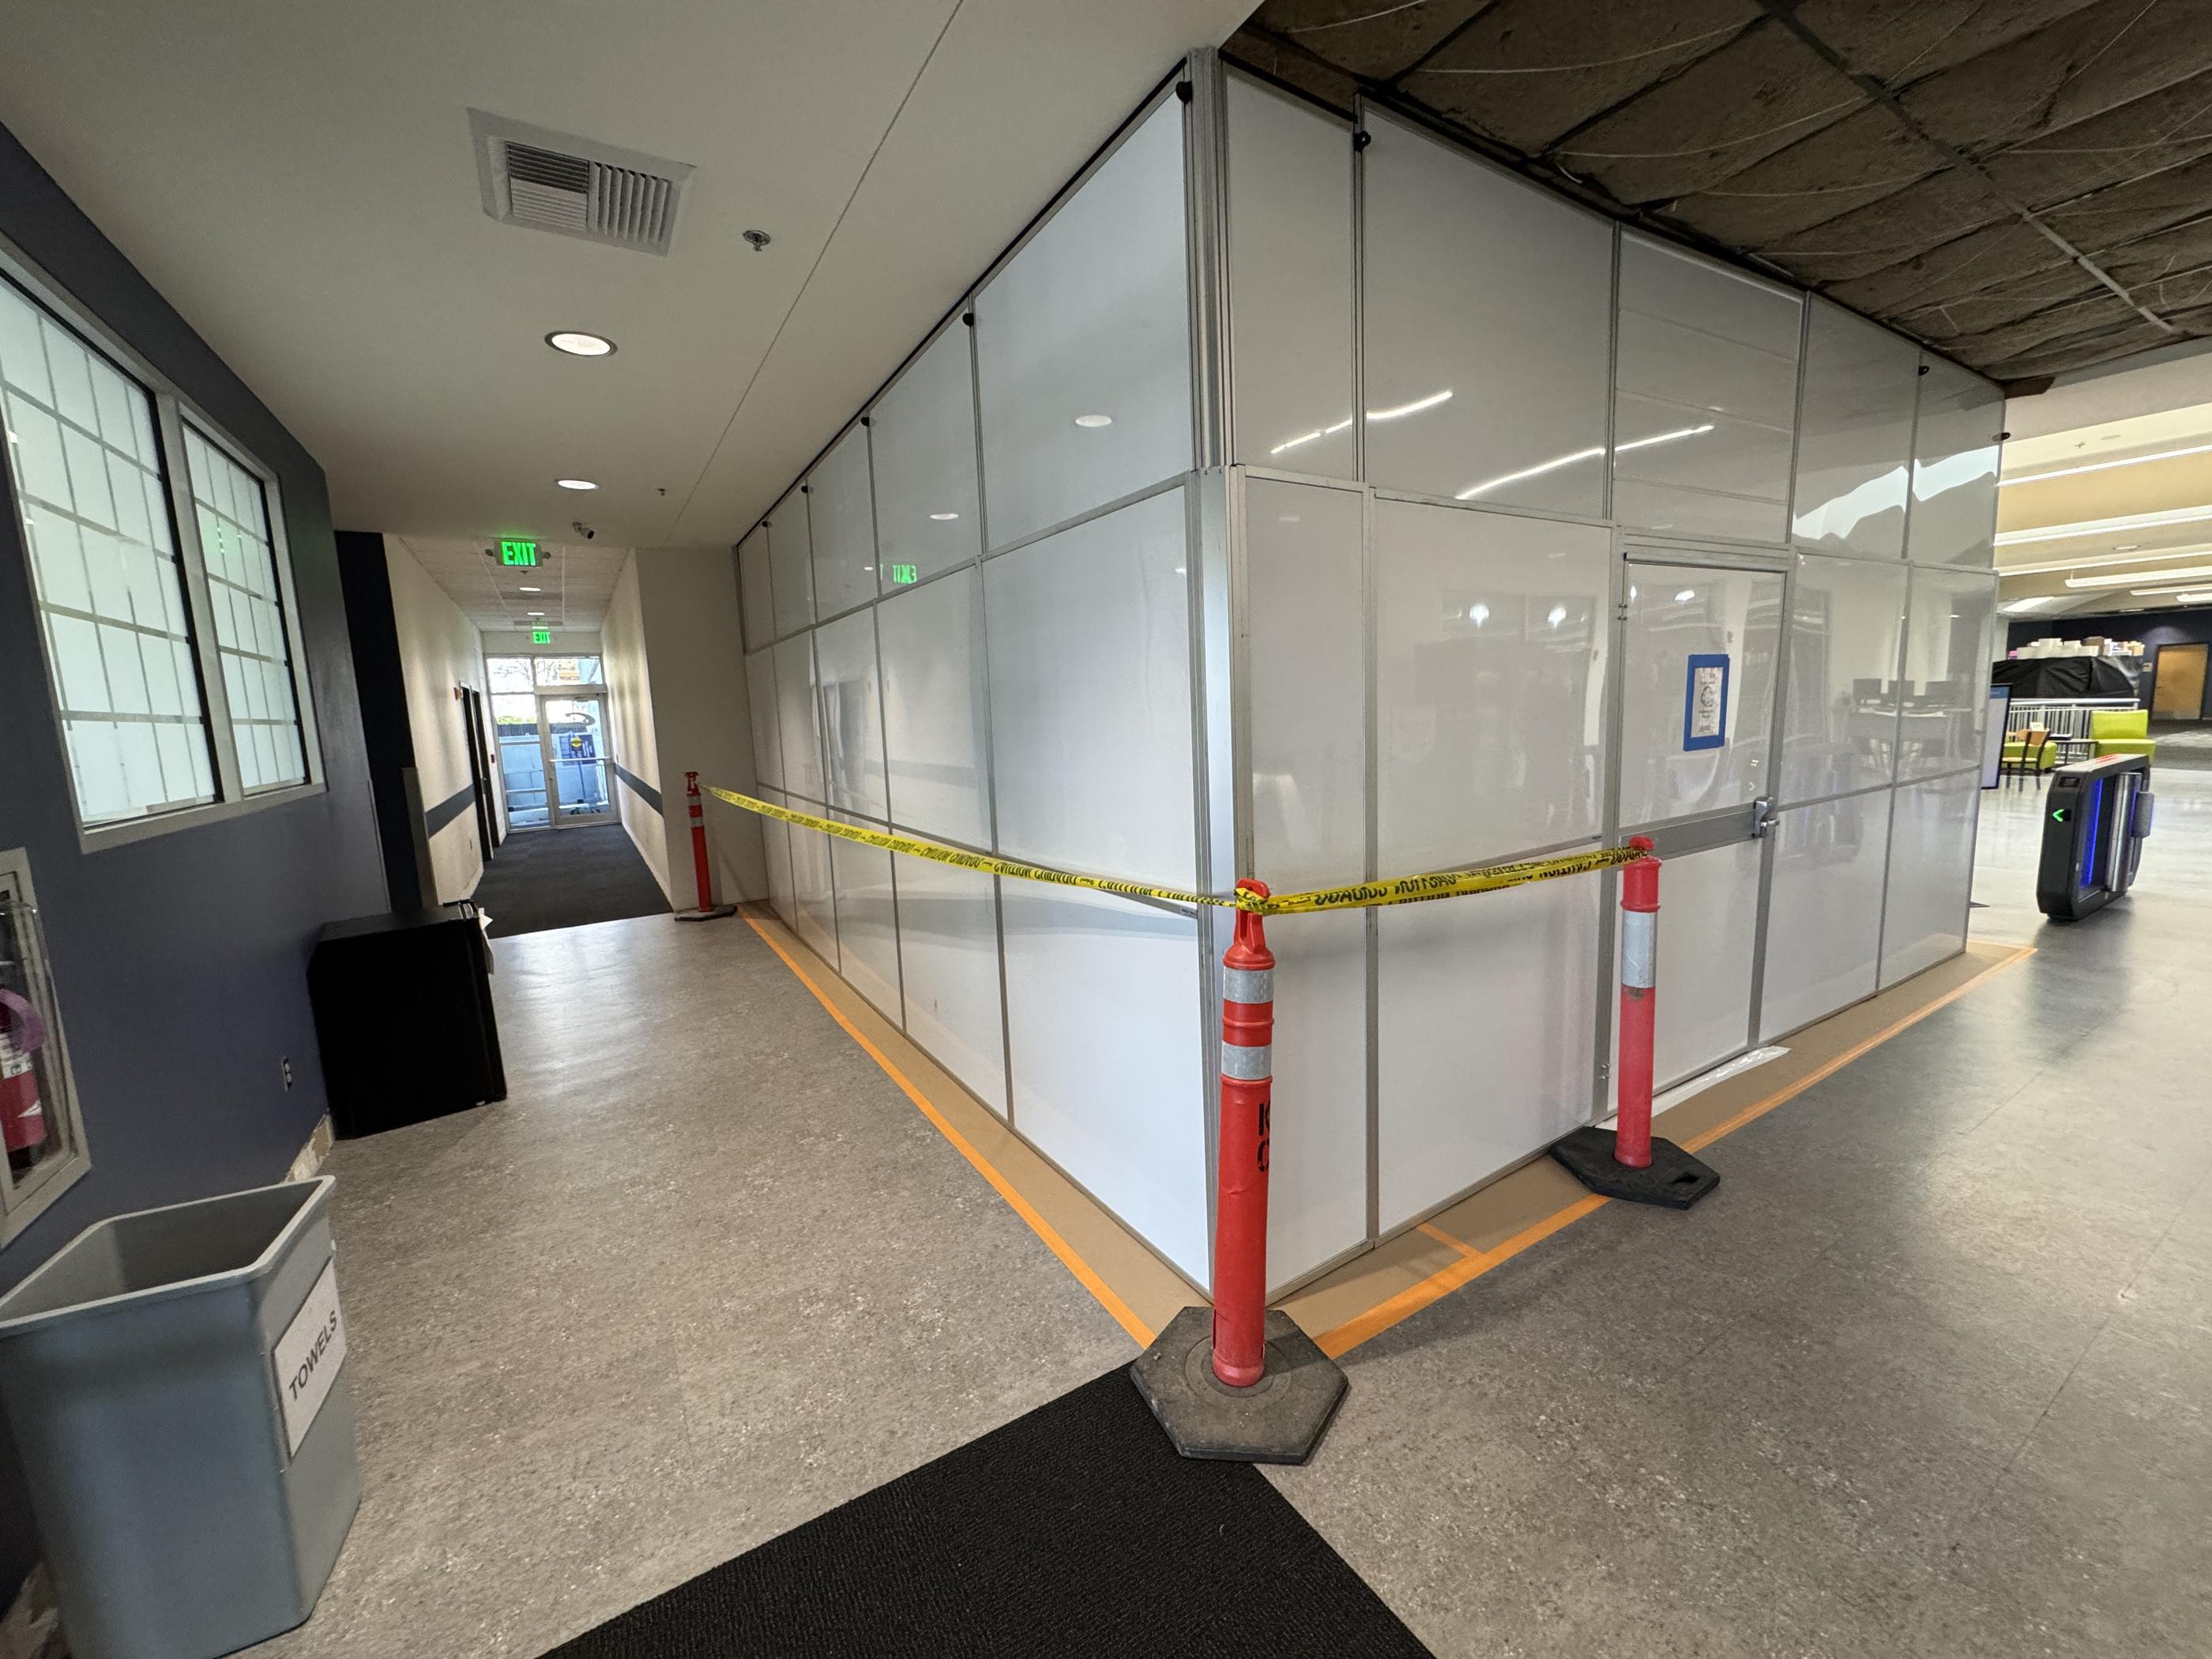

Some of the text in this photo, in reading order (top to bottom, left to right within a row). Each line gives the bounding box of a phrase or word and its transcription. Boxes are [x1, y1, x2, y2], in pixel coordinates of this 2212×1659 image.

[501, 541, 536, 566] EXIT
[532, 631, 551, 645] EXIT
[289, 1310, 337, 1401] TOWELS
